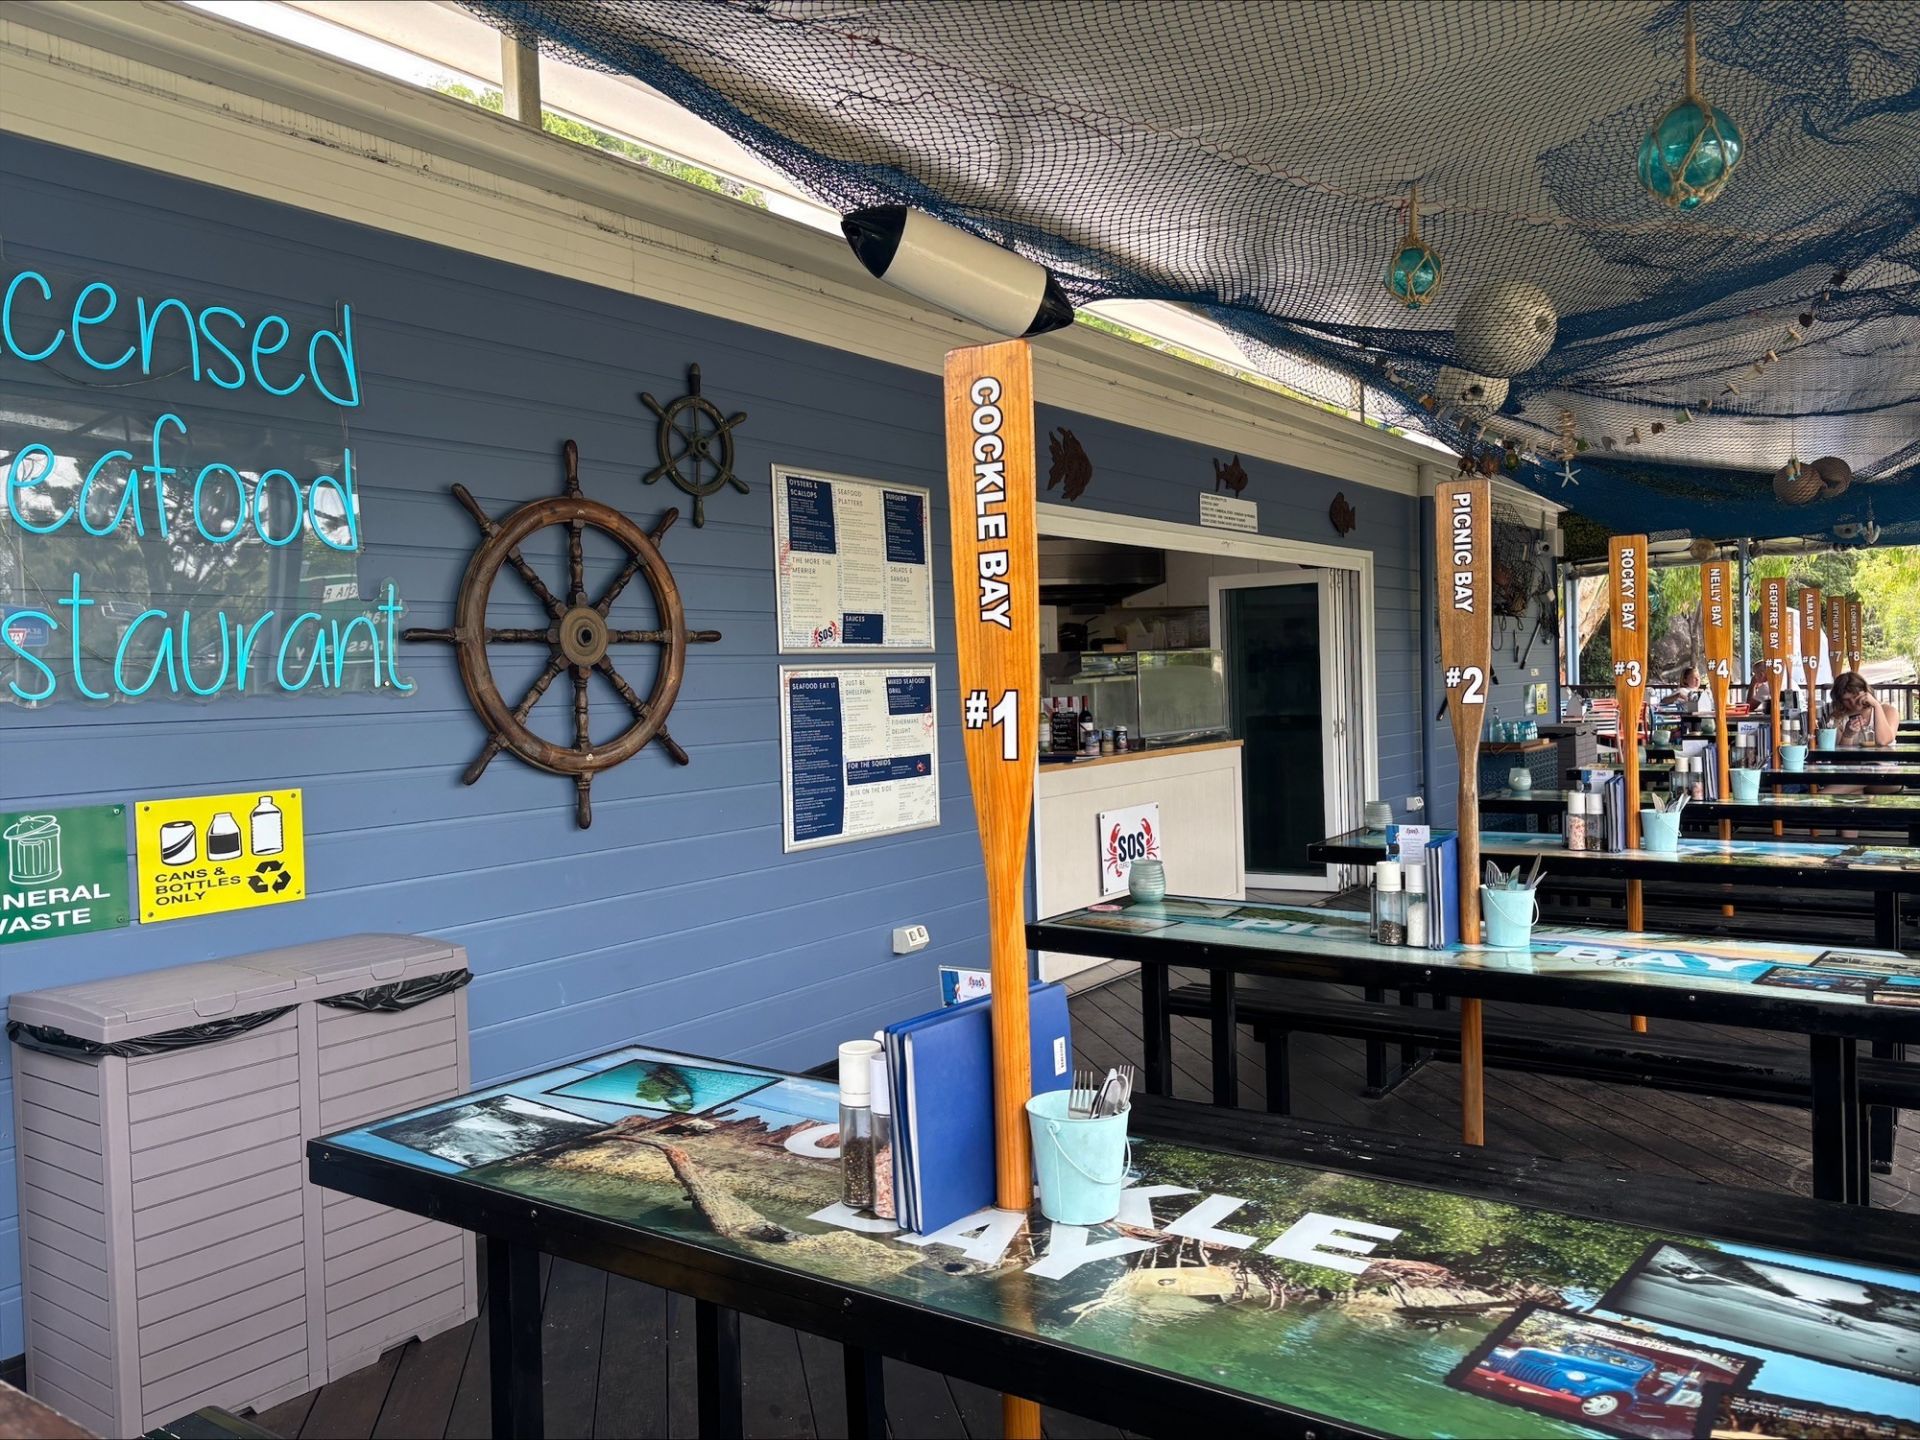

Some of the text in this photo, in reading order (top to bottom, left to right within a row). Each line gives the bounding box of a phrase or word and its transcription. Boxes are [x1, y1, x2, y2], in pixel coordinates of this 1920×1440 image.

[0, 271, 359, 407] censed
[6, 414, 358, 551] eafood
[789, 479, 812, 489] OYSTERS
[790, 488, 817, 499] SCALLOPS
[837, 488, 862, 497] SEAFOOD
[885, 493, 908, 502] BURGERS
[838, 498, 863, 507] PLATTERS
[969, 376, 1012, 631] COCKLE BAY
[1452, 492, 1474, 614] PICNIC BAY
[791, 567, 816, 575] MERRIER
[890, 566, 908, 574] SALADS
[1620, 547, 1636, 632] ROCKY BAY
[1710, 568, 1722, 628] NELLY BAY
[1769, 583, 1779, 650] GEOFFREY BAY
[1806, 593, 1814, 631] ALMA BAY
[1832, 601, 1840, 643] ARTHUR BAY
[1, 575, 411, 702] staurant
[818, 627, 834, 642] SOS
[1803, 655, 1817, 669] #6
[1830, 651, 1841, 662] #7
[1848, 651, 1860, 661] #8
[1614, 660, 1642, 687] #3
[1707, 658, 1729, 679] #4
[1765, 658, 1783, 675] #5
[792, 682, 818, 690] SEAFOOD
[819, 682, 830, 690] EAT
[844, 679, 858, 687] JUST
[903, 677, 925, 685] SEAFOOD
[1445, 665, 1484, 705] #2
[891, 727, 911, 735] DELIGHT
[964, 689, 1020, 761] #1
[847, 759, 891, 770] FOR THE SQUIDS
[882, 785, 892, 793] SIDE
[1117, 830, 1145, 863] SOS
[155, 866, 226, 884] CANS &
[155, 875, 241, 895] BOTTLES
[0, 883, 111, 910] NERAL
[155, 891, 206, 906] ONLY
[1553, 945, 1763, 972] BAY
